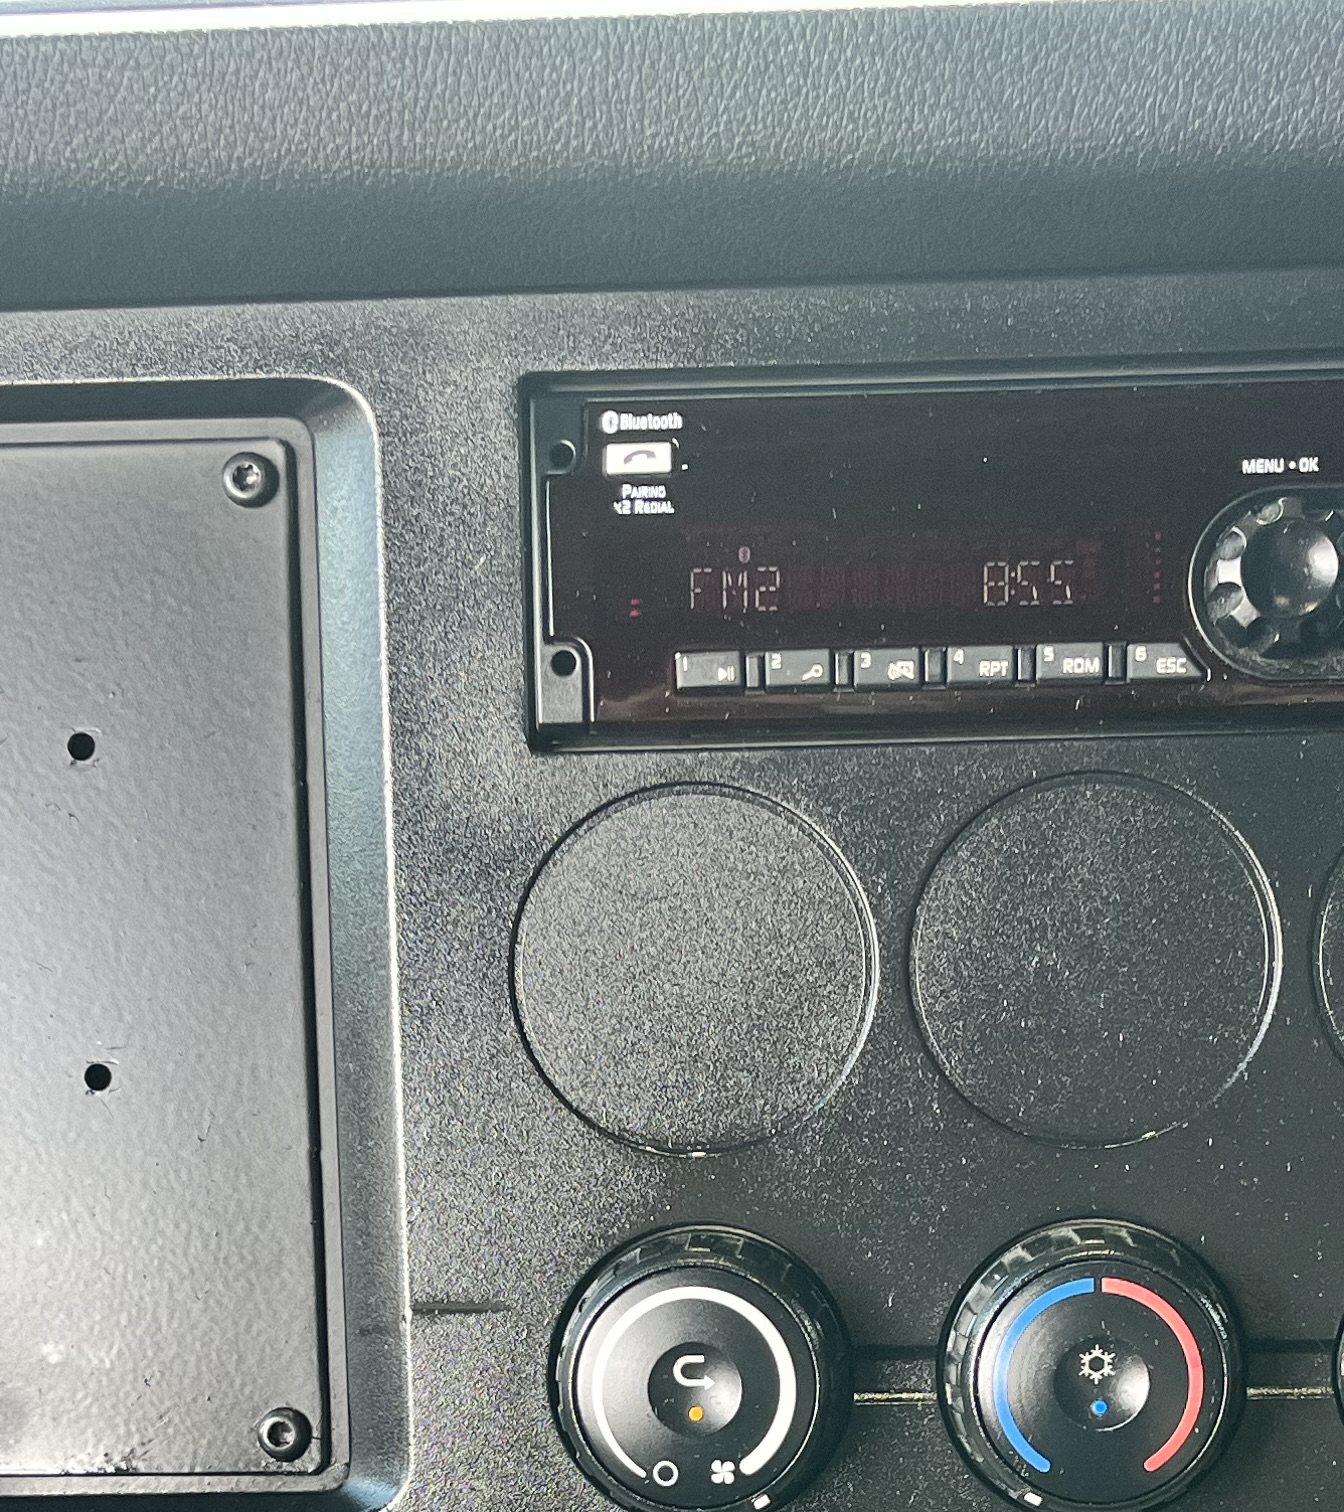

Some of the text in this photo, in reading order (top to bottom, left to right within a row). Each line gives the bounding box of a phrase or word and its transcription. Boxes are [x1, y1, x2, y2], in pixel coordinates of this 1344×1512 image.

[619, 411, 683, 431] Bluetooth
[1242, 456, 1320, 475] MENU OK
[983, 560, 1076, 606] 8:55
[771, 652, 782, 670] 2
[860, 651, 873, 669] 3
[953, 648, 965, 665] 4
[1044, 645, 1055, 662] 5
[1135, 645, 1147, 662] 6
[979, 660, 1009, 677] RPT
[1062, 657, 1100, 674] RDM
[1156, 657, 1187, 674] ESC
